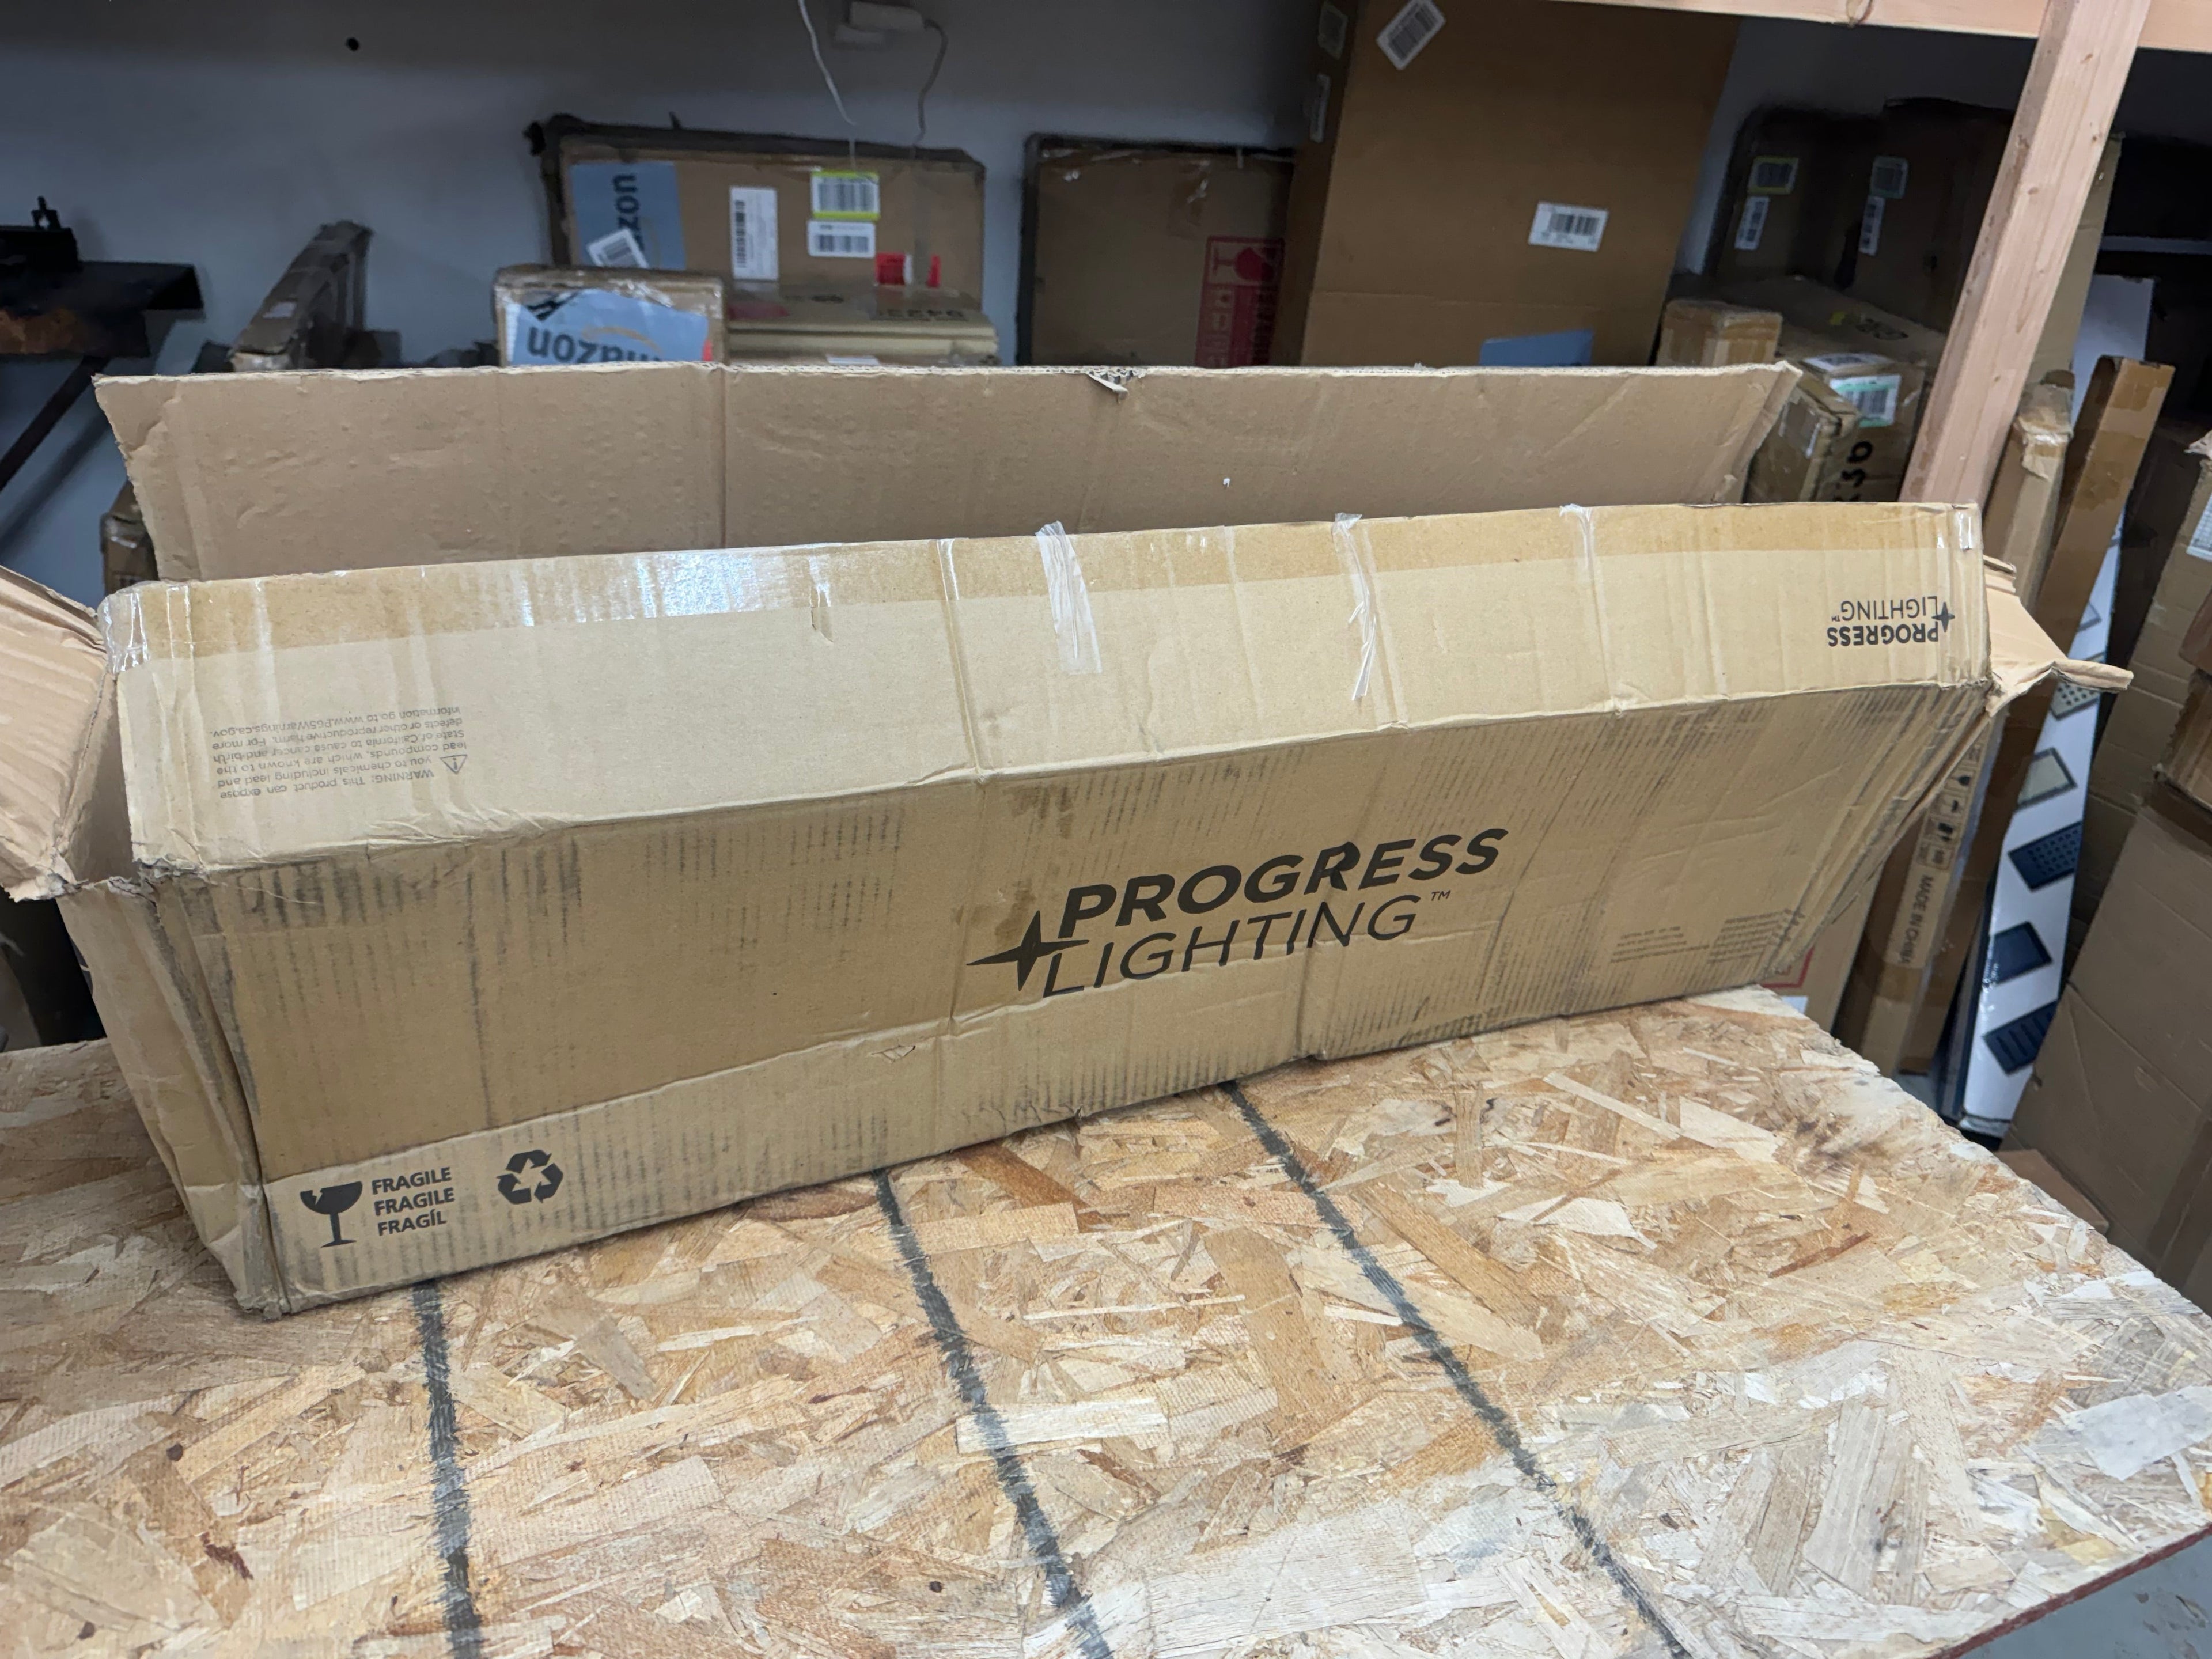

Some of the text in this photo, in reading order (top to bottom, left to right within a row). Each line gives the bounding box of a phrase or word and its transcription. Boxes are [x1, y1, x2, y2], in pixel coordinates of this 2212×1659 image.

[1840, 596, 1937, 622] LIGHTING
[1827, 620, 1938, 647] PROGRESS
[366, 713, 378, 722] to
[381, 711, 396, 720] go
[379, 724, 407, 734] other
[425, 718, 463, 728] defects
[306, 726, 376, 740] reproductive
[421, 732, 433, 740] of
[436, 729, 465, 739] State
[212, 740, 243, 750] more
[247, 738, 266, 747] For
[366, 734, 418, 747] California
[271, 747, 310, 756] cancer
[314, 742, 347, 753] cause
[213, 752, 243, 764] birth
[217, 741, 467, 775] lead compounds, which are known to the
[246, 749, 268, 760] and
[410, 756, 432, 766] you
[275, 767, 329, 781] including
[334, 762, 391, 775] chemicals
[218, 778, 241, 789] and
[220, 768, 434, 799] WARNING: This product can expose
[245, 774, 270, 785] lead
[1058, 828, 1509, 939] PROGRESS
[1913, 874, 1934, 911] MADE
[1909, 913, 1923, 927] IN
[1043, 894, 1421, 998] LIGHTING
[372, 1166, 452, 1195] FRAGILE
[374, 1187, 455, 1216] FRAGILE
[377, 1209, 447, 1236] FRAGÍL
